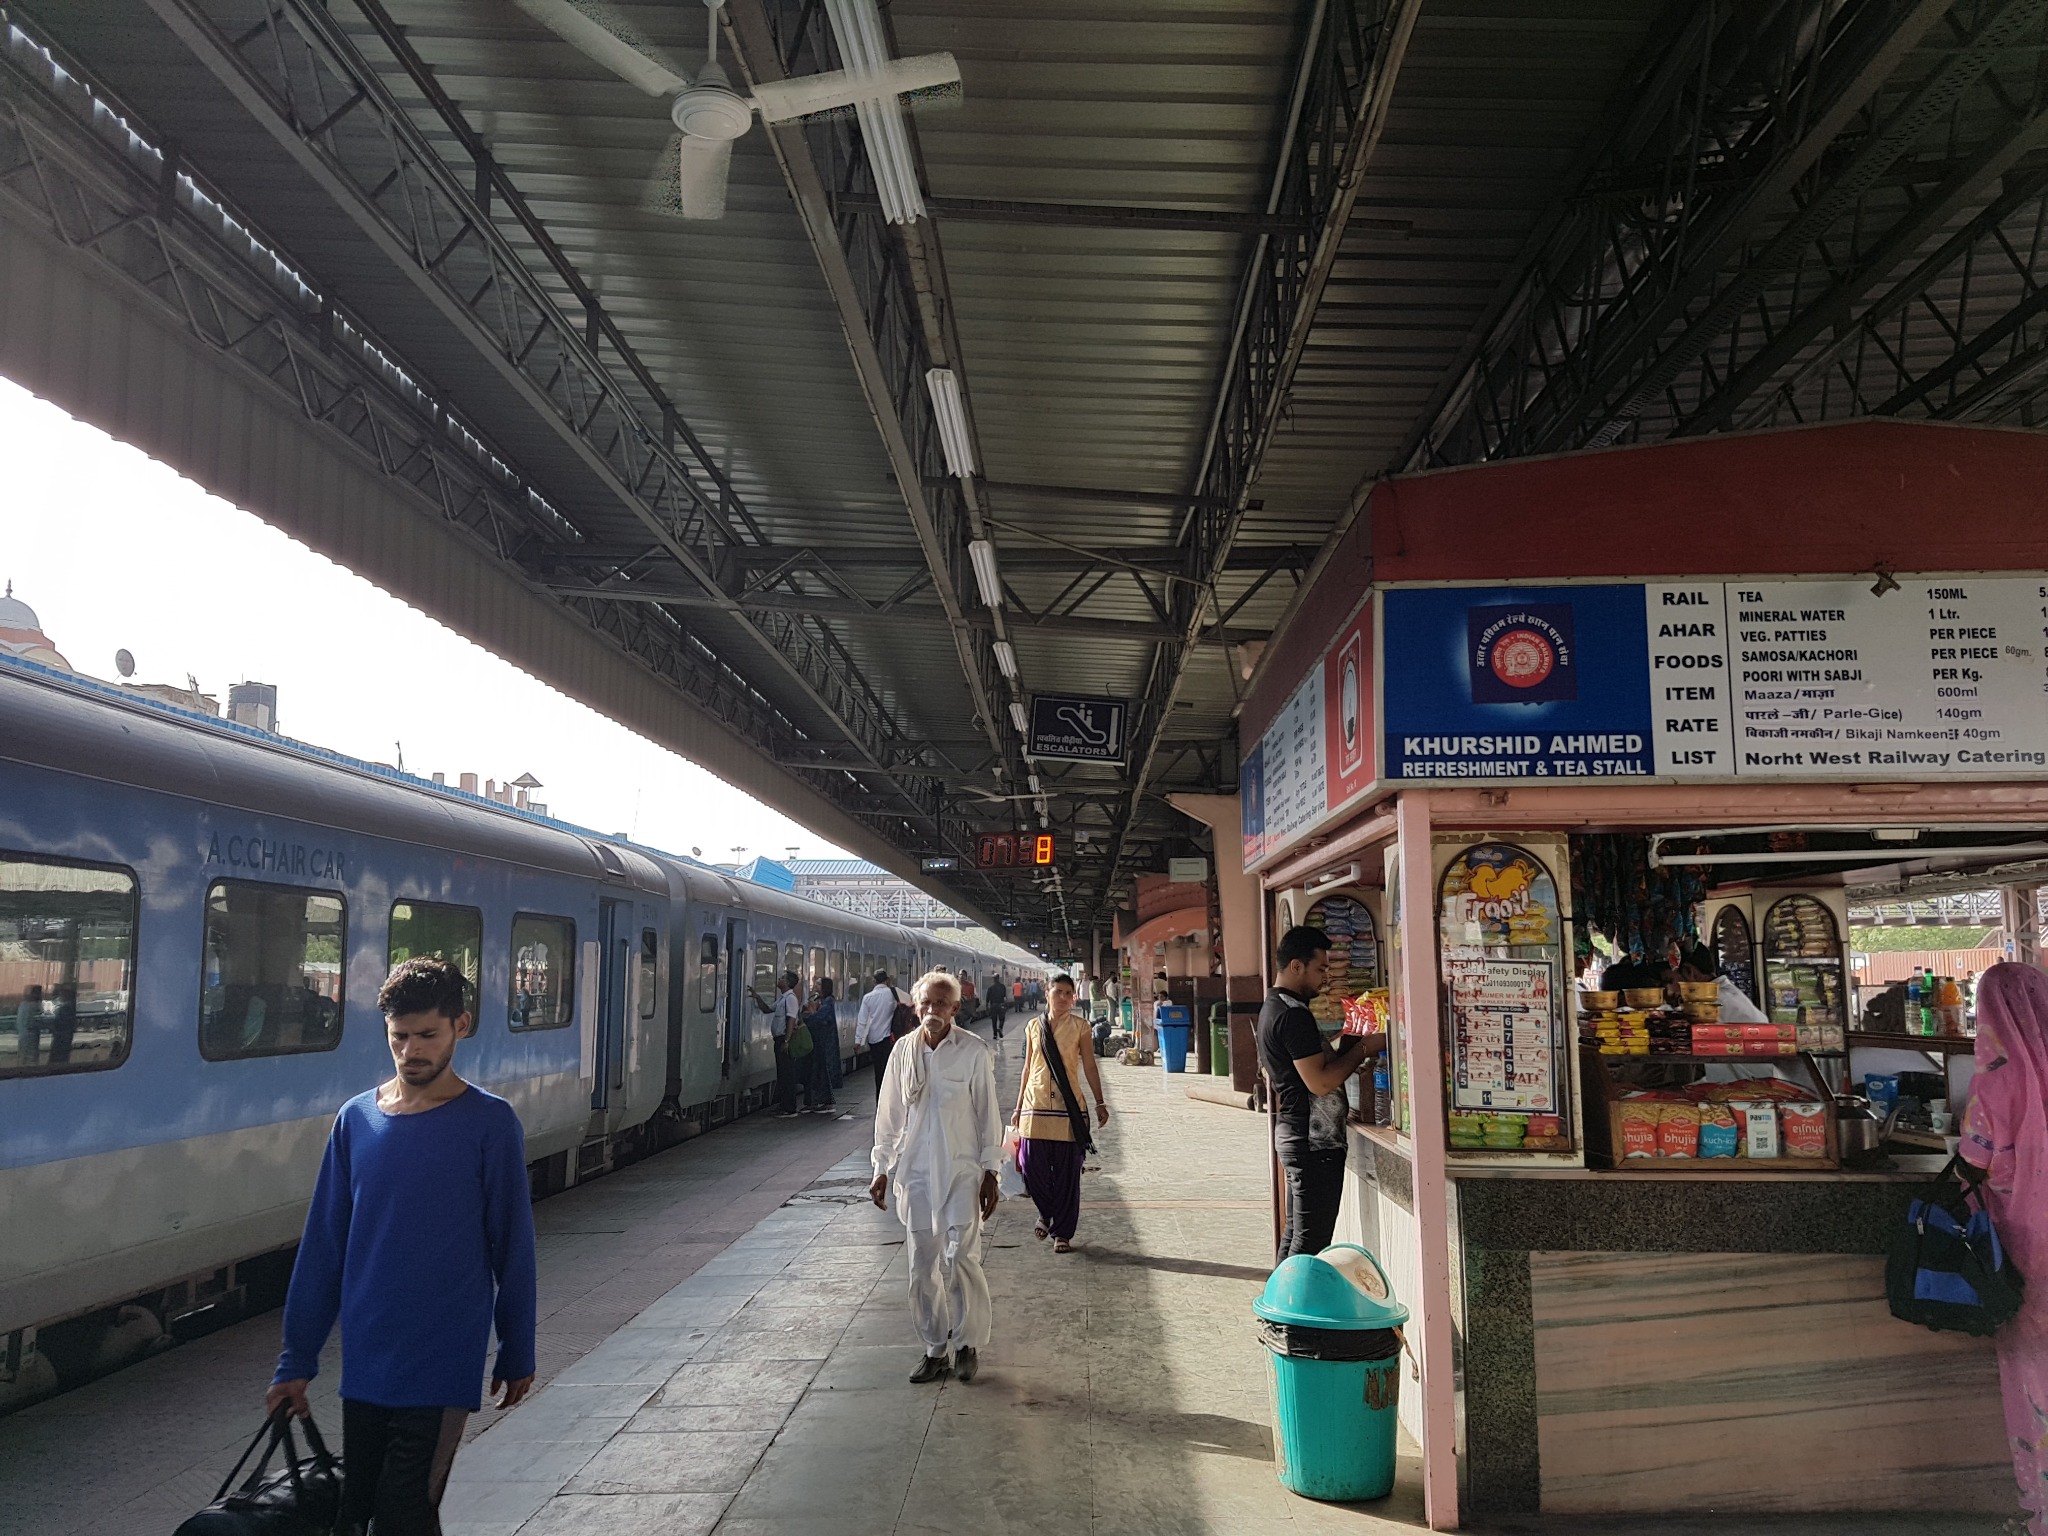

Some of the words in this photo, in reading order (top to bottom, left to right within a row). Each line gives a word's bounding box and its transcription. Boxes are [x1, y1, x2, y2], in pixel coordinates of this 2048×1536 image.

[1662, 592, 1709, 606] RAIL
[1738, 591, 1763, 602] TEA
[1927, 588, 1967, 600] 150ML
[1739, 610, 1797, 622] MINERAL
[1800, 610, 1845, 621] WATER
[1928, 608, 1935, 619] 1
[1940, 608, 1960, 620] Ltr.
[1659, 623, 1716, 638] AHAR
[1740, 631, 1771, 642] VEG.
[1775, 630, 1827, 641] PATTIES
[1930, 628, 1955, 639] PER
[1959, 627, 1997, 639] PIECE
[1654, 654, 1724, 669] FOODS
[1741, 649, 1858, 662] SAMOSA/KACHORI
[1931, 648, 1956, 660] PER
[1960, 647, 1998, 659] PIECE
[1743, 670, 1783, 682] POORI
[1787, 670, 1820, 681] WITH
[1824, 669, 1862, 681] SABJI
[1932, 668, 1958, 680] PER
[1962, 668, 1983, 681] Kg.
[1665, 686, 1716, 701] ITEM
[1937, 686, 1978, 698] 600ml
[1936, 707, 1982, 720] 140gm
[1665, 718, 1719, 733] RATE
[1845, 728, 1882, 741] Bikaji
[1963, 728, 2001, 740] 40gm
[1036, 743, 1107, 756] ESCALATORS
[1404, 735, 1541, 756] KHURSHID
[1548, 734, 1643, 754] AHMED
[1671, 750, 1717, 765] LIST
[1745, 752, 1803, 765] Norht
[1809, 751, 1861, 765] West
[1868, 750, 1950, 767] Railway
[1957, 749, 2046, 765] Catering
[1402, 760, 1530, 777] REFRESHMENT
[1535, 760, 1548, 776] &
[1553, 760, 1588, 775] TEA
[1593, 759, 1647, 775] STALL
[310, 848, 346, 880] CAR
[1481, 966, 1510, 977] Safety
[1512, 967, 1547, 979] Display
[1505, 1017, 1511, 1025] 6
[1482, 1093, 1491, 1102] 11
[1664, 1132, 1697, 1146] bhujia
